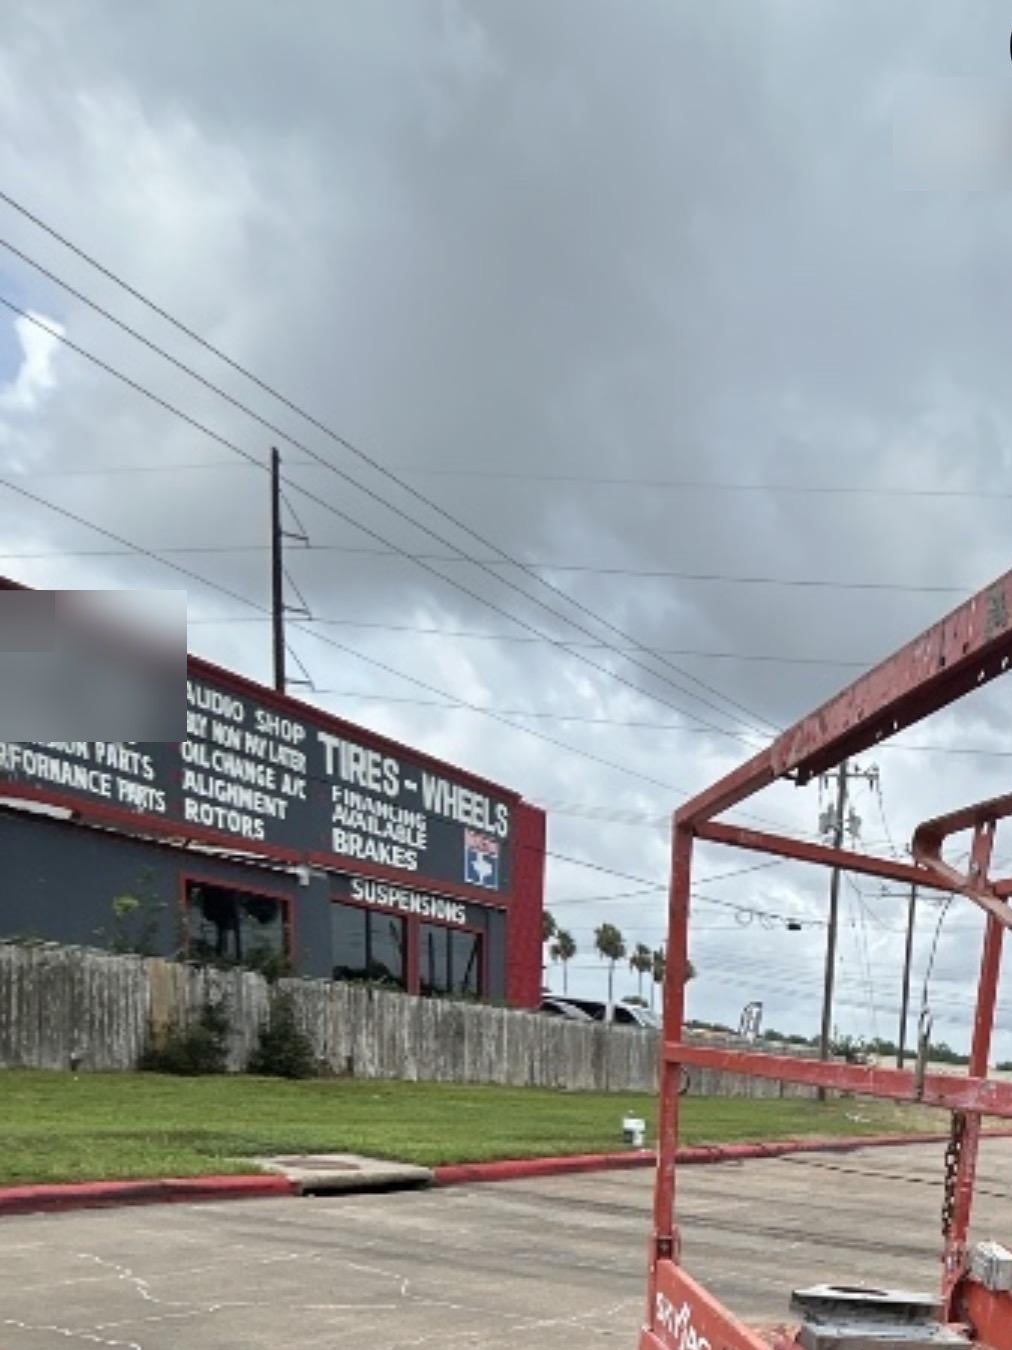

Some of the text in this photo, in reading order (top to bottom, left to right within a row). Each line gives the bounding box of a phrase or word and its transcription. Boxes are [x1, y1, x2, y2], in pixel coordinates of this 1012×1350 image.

[255, 710, 306, 745] SHOP
[95, 742, 154, 781] PARTS
[181, 741, 210, 769] OIL
[212, 750, 276, 790] CHANGE
[116, 777, 167, 813] PARTS
[182, 769, 288, 820] ALIGNMENT
[317, 731, 400, 797] TIRES
[422, 772, 508, 838] WHEELS
[184, 798, 265, 841] ROTORS
[332, 785, 426, 832] FINANCING
[332, 805, 427, 850] AVAILABLE
[332, 827, 418, 871] BRAKES
[351, 878, 466, 925] SUSPENSIONS
